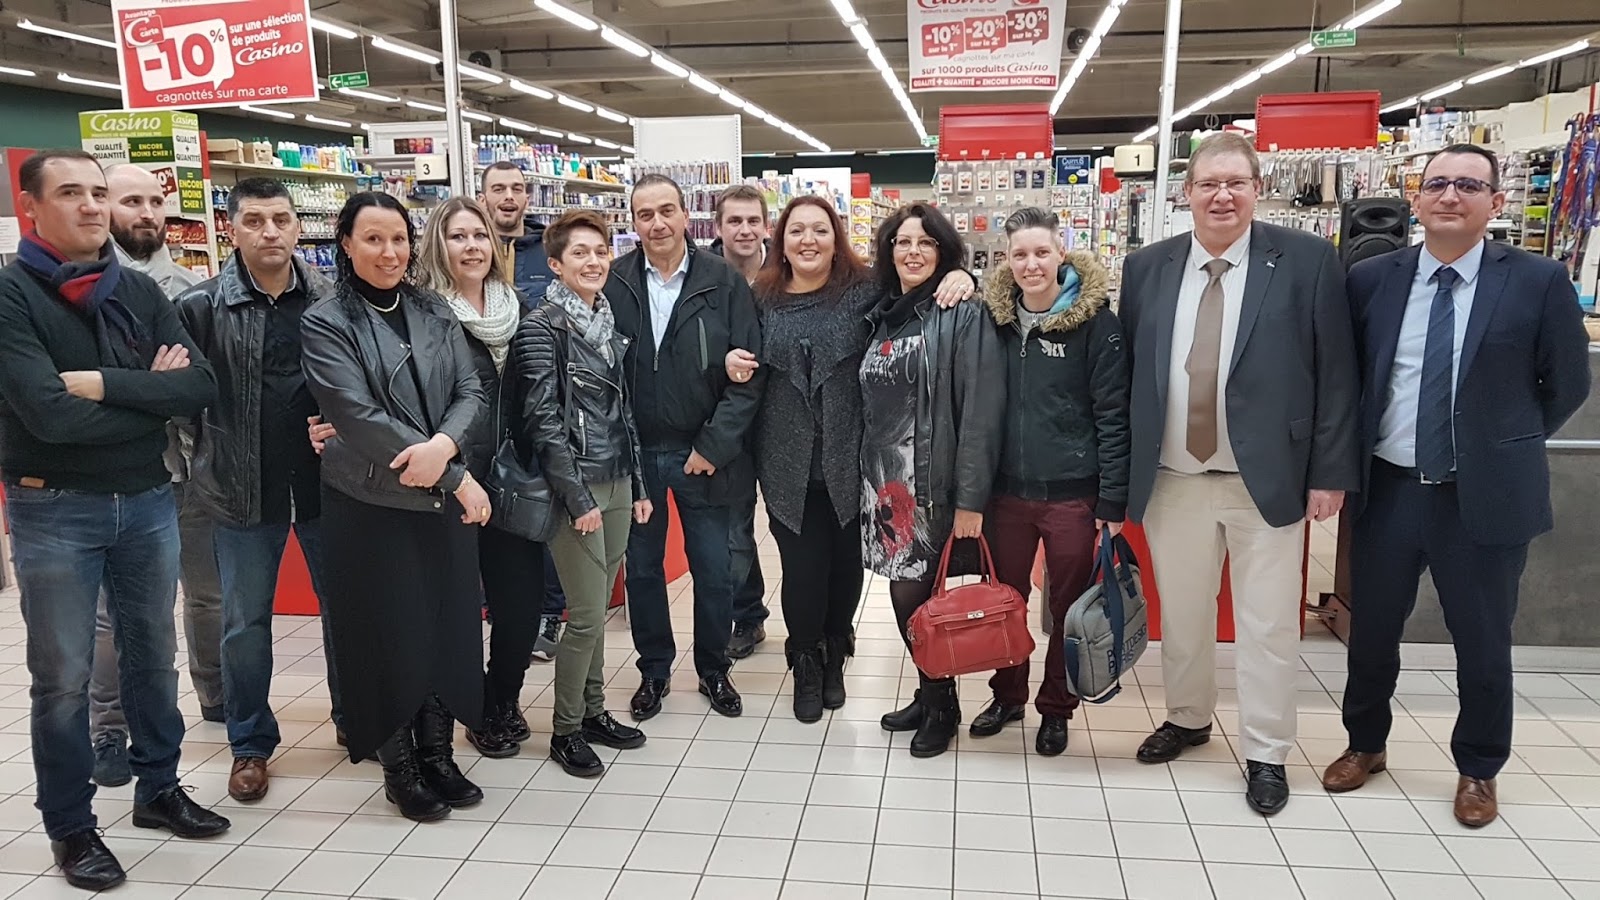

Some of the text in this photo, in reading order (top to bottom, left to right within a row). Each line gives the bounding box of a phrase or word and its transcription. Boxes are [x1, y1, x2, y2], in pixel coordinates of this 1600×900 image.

[124, 9, 156, 19] Avantage
[1008, 10, 1047, 30] -30%
[229, 12, 304, 34] sur une sélection
[966, 18, 1004, 38] -20%
[140, 28, 159, 37] carte
[232, 29, 281, 46] de produits
[925, 24, 960, 44] -10%
[144, 28, 225, 80] -10%
[235, 41, 304, 66] Casino
[938, 66, 962, 74] 1000
[965, 65, 1005, 74] produits
[1007, 62, 1048, 73] Casino
[913, 78, 936, 87] QUALITÉ
[944, 78, 975, 86] QUANTITÉ
[156, 84, 288, 104] cagnottés sur ma carte
[90, 113, 161, 132] Casino
[172, 114, 197, 126] Casino
[176, 135, 197, 144] QUALITÉ
[94, 142, 122, 151] QUALITÉ
[176, 153, 200, 162] QUANTITÉ
[1134, 154, 1140, 166] 1
[423, 164, 430, 175] 3
[179, 179, 203, 189] ENCORE
[182, 190, 202, 198] MOINS
